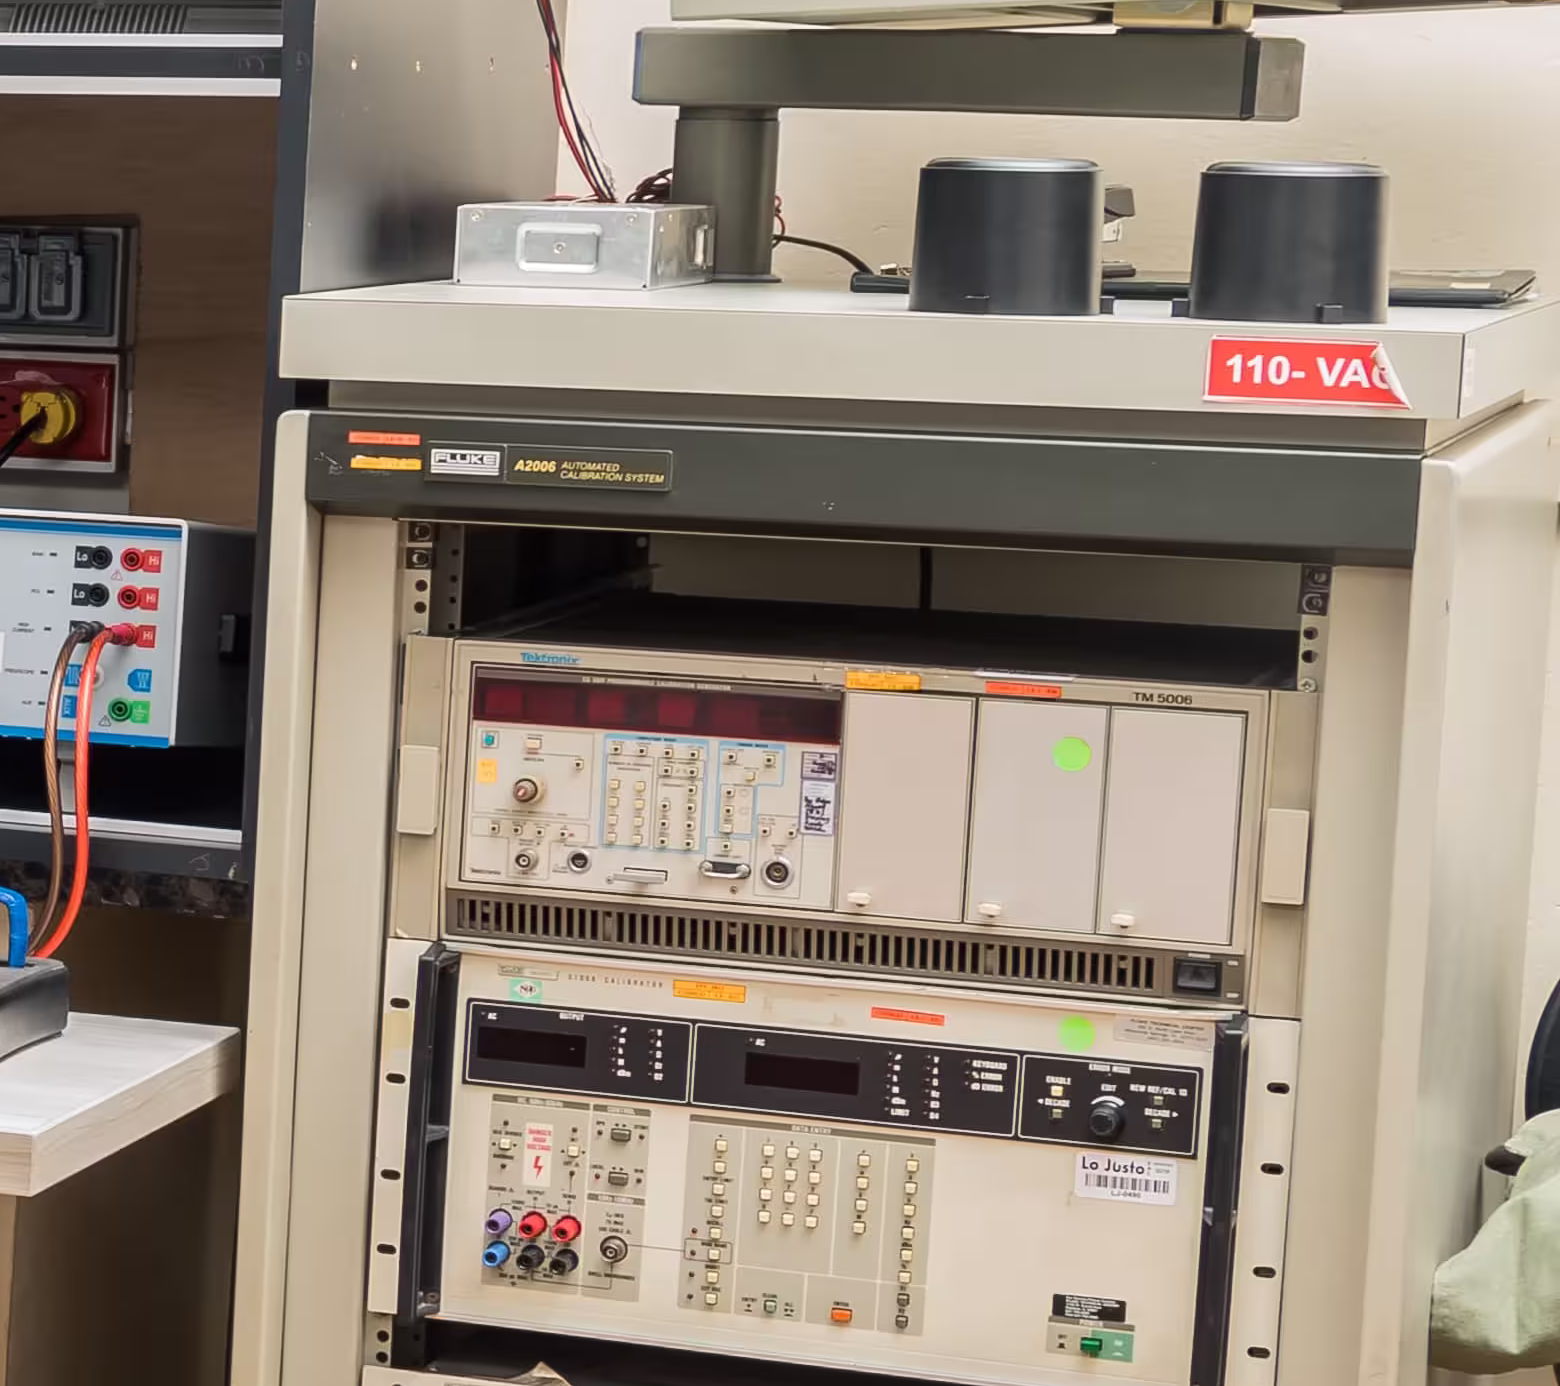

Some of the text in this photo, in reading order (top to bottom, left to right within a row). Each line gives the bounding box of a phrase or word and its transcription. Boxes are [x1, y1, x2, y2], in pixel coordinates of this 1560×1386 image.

[1225, 354, 1306, 386] 110-
[433, 453, 498, 466] FLUKE
[513, 459, 557, 474] A2006
[560, 461, 620, 473] AUTOMATED
[560, 469, 665, 485] CALIBRATION SYSTEM
[77, 552, 88, 562] Lo
[149, 556, 160, 566] Hi
[74, 589, 86, 599] Lo
[146, 594, 157, 604] Hi
[143, 631, 153, 641] Hi
[521, 651, 580, 666] Tektronix
[1132, 692, 1193, 706] TM 5006
[604, 977, 664, 989] CALIBRATOR
[972, 1059, 1008, 1071] KEYBOARD
[1046, 1075, 1072, 1086] ENABLE
[791, 1124, 832, 1135] DATA ENTRY
[1081, 1155, 1145, 1175] Lo Justo
